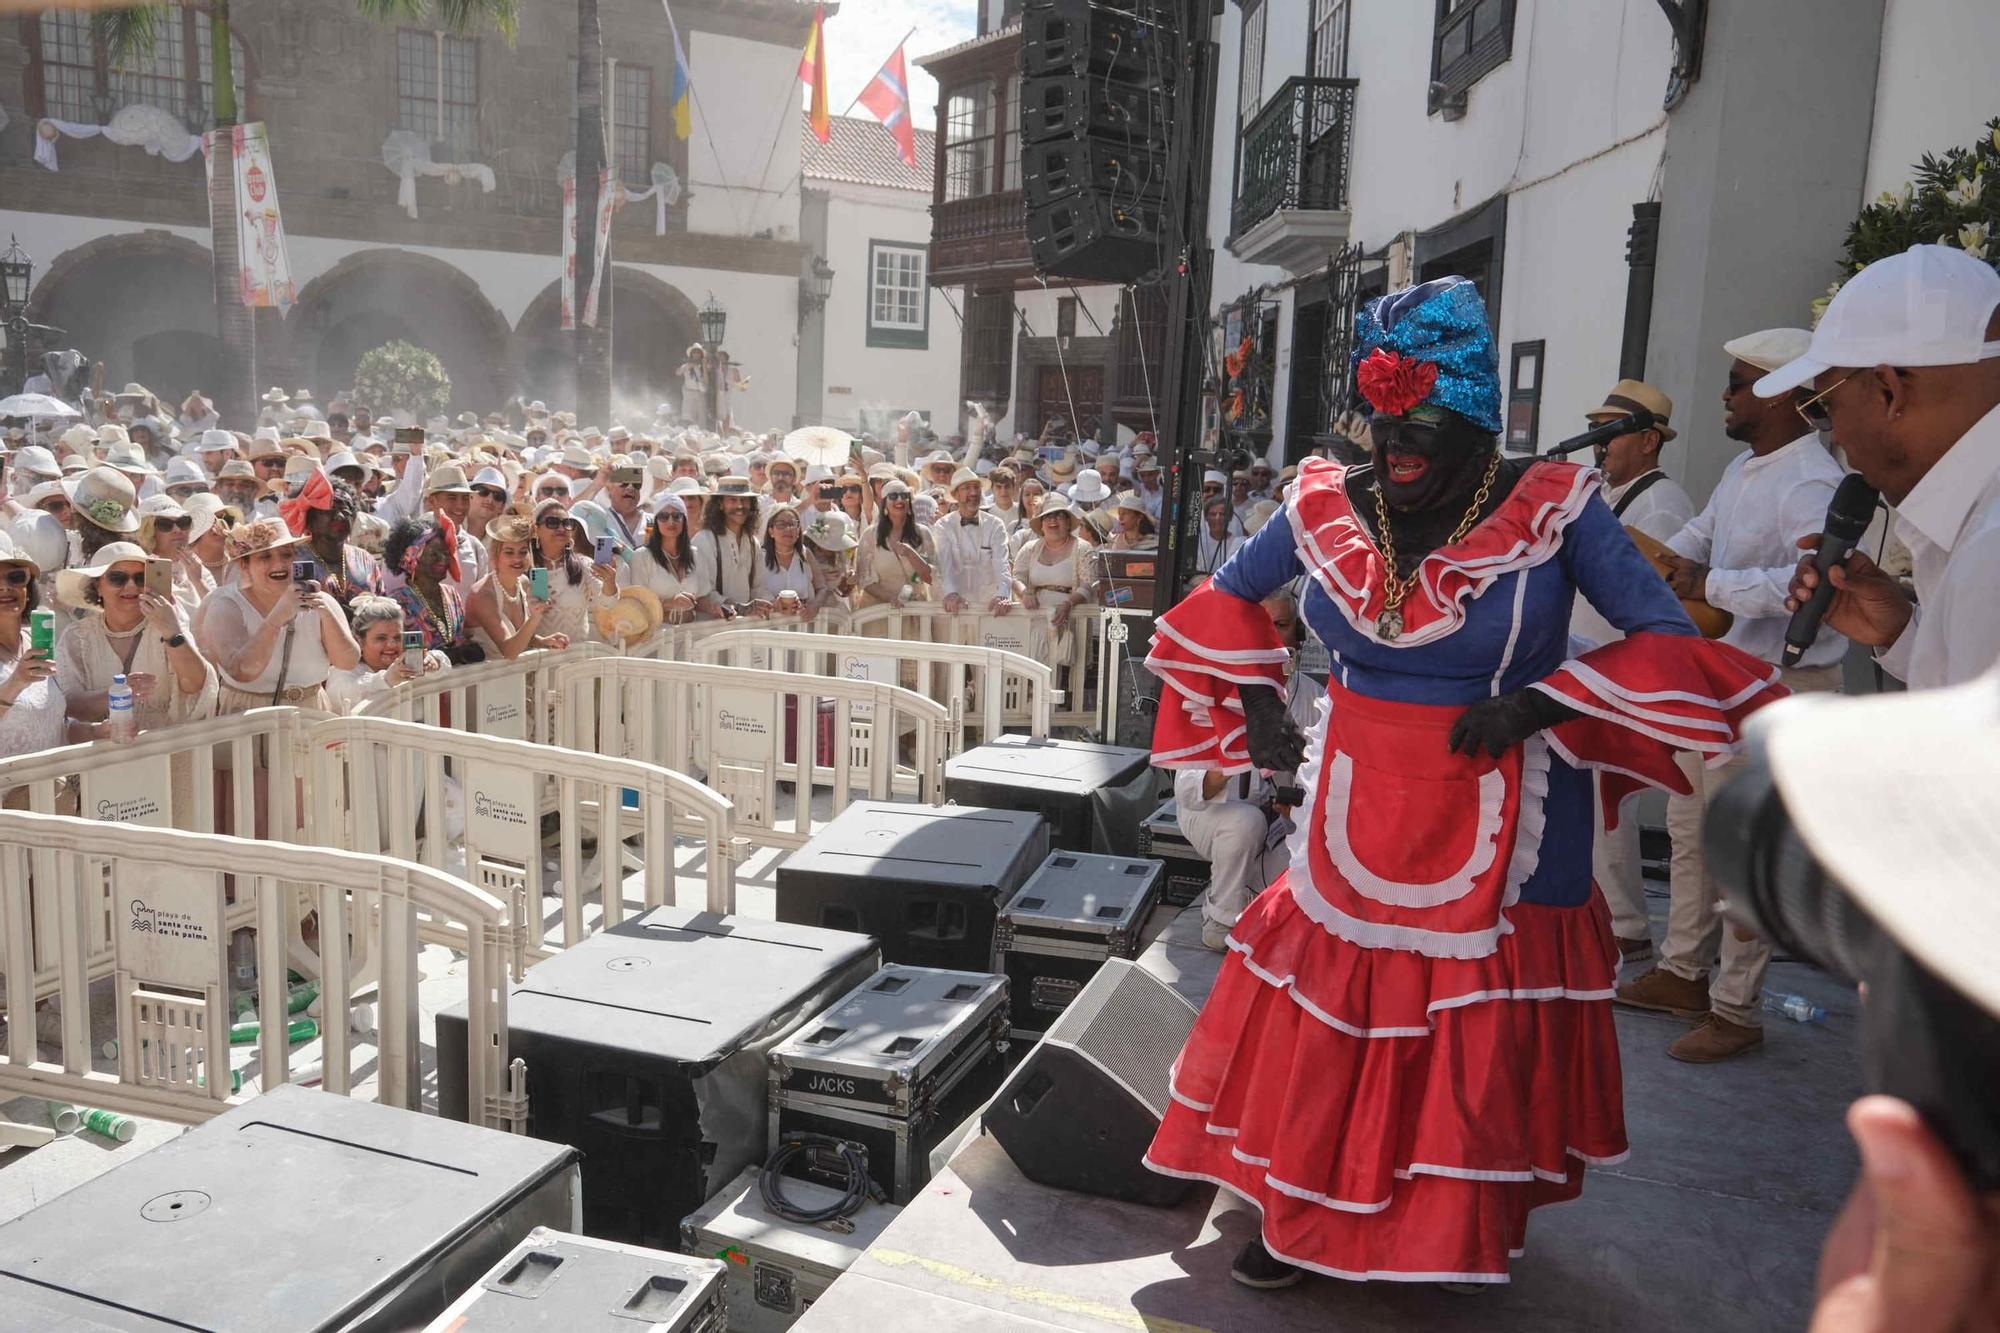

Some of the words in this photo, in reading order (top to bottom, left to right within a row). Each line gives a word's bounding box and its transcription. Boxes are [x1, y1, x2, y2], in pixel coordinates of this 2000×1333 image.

[120, 806, 139, 814] santa
[139, 807, 159, 816] palma
[157, 911, 179, 920] playa
[158, 921, 181, 929] santa
[184, 924, 202, 932] cruz
[171, 929, 179, 937] la
[182, 932, 207, 940] palma
[808, 1075, 855, 1095] JACKS
